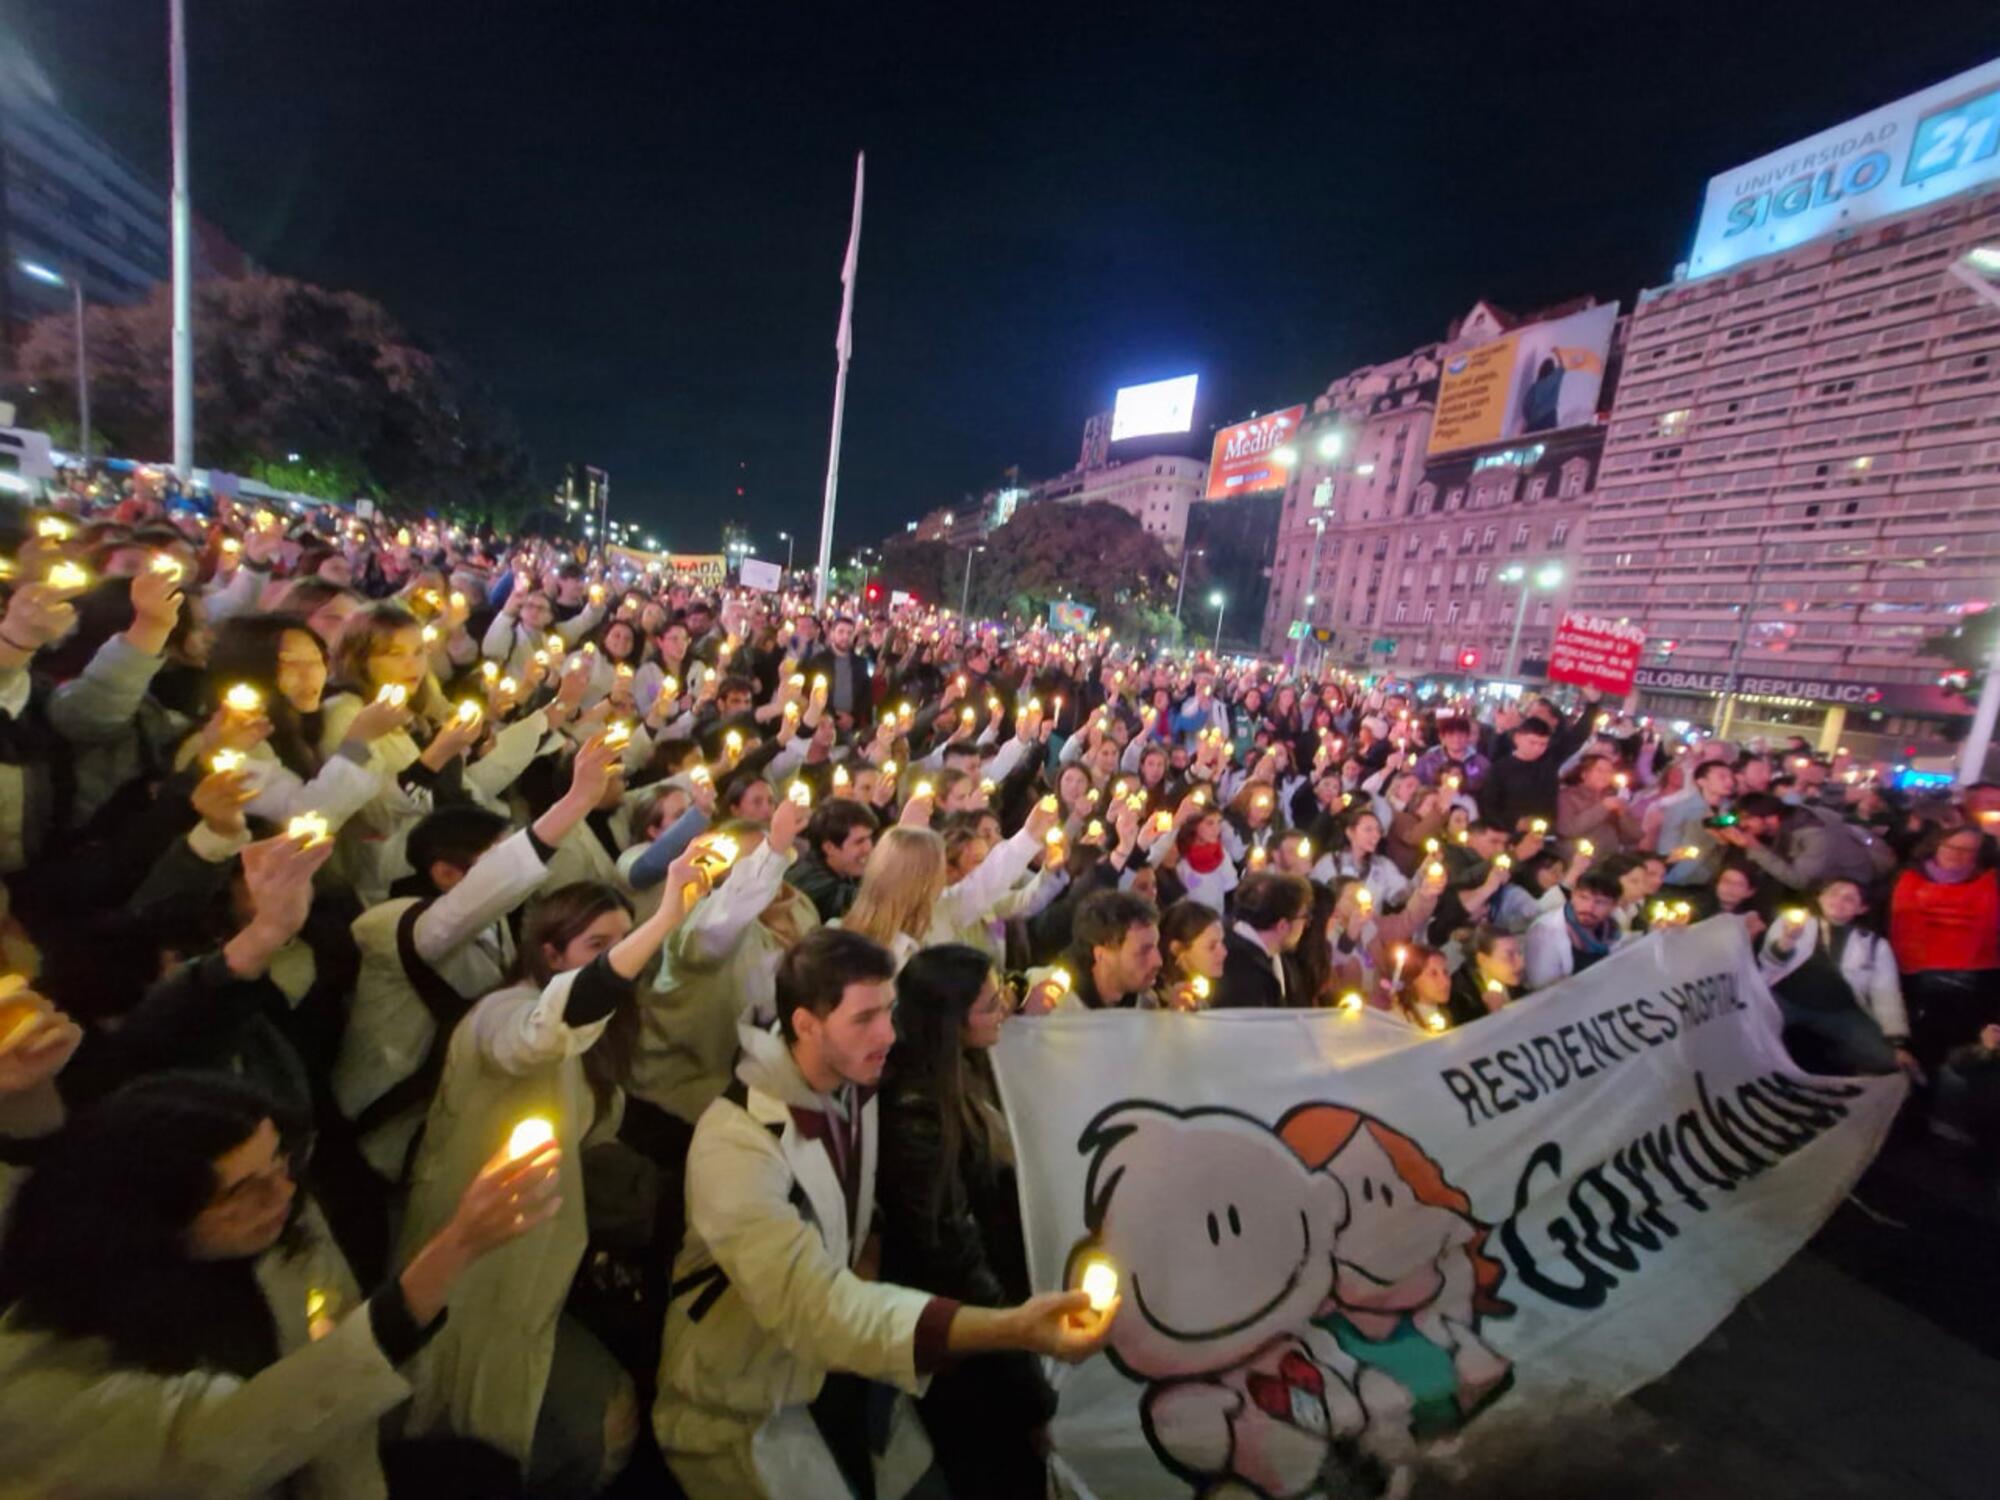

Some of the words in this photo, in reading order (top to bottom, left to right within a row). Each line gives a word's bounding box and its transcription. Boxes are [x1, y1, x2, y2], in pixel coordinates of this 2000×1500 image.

[1723, 150, 1891, 238] SIGLO
[1917, 115, 1994, 169] 21
[1735, 122, 1898, 196] UNIVERSIDAD
[1440, 997, 1678, 1127] RESIDENTES
